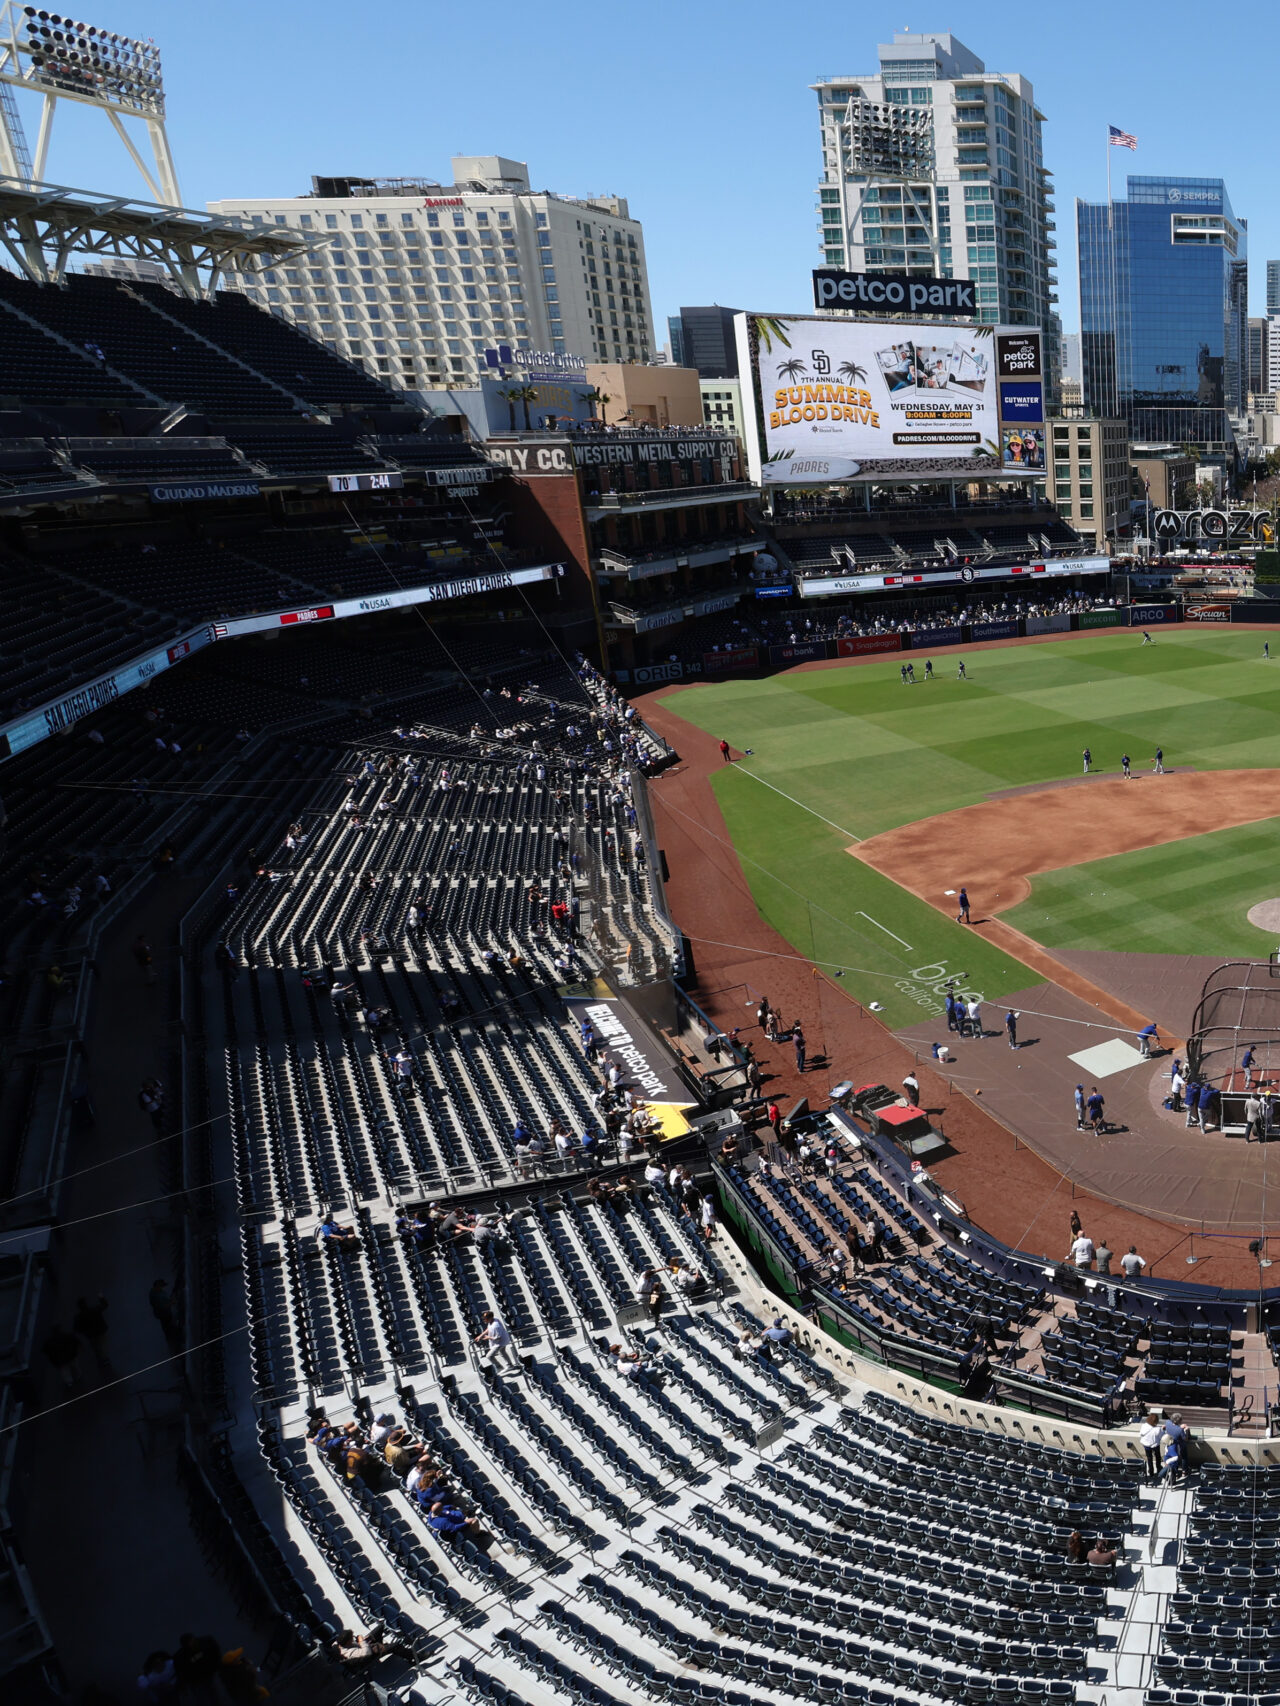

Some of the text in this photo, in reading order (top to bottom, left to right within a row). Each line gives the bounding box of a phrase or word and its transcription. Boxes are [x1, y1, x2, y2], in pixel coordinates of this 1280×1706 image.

[1183, 191, 1220, 201] SEMPRA
[423, 198, 463, 208] Marriott
[817, 275, 973, 311] petco park
[515, 349, 586, 369] QuidelOrtho
[1004, 352, 1035, 363] petco
[1010, 361, 1035, 371] park
[815, 376, 844, 384] ANNUAL
[774, 384, 873, 409] SUMMER
[1004, 396, 1040, 404] CUTWATER
[891, 403, 985, 412] WEDNESDAY, MAY 31
[769, 404, 881, 430] BLOOD DRIVE
[905, 411, 972, 419] 9:00AM 6:00PM
[897, 434, 977, 442] PADRES.COM/BLOODDRIVE
[573, 441, 737, 465] WESTERN METAL SUPPLY CO.
[536, 448, 573, 471] CO.
[790, 460, 830, 475] PADRES
[370, 475, 390, 489] 2:44
[436, 468, 487, 485] CUTWATER
[154, 484, 260, 500] CIUDAD MADERAS
[447, 486, 479, 498] SPIRITS
[1184, 510, 1271, 540] razr
[429, 573, 513, 601] SAN DIEGO PADRES
[842, 581, 860, 589] USAA
[758, 588, 788, 597] PARADYM
[369, 598, 391, 611] USAA
[296, 610, 318, 621] PADRES
[1083, 614, 1117, 624] dexcom
[1132, 609, 1164, 621] ARCO
[1186, 605, 1226, 621] Sycuan
[974, 625, 1011, 637] Southwest
[855, 639, 897, 650] Snapdragon
[794, 647, 815, 656] bank
[636, 664, 682, 682] ORIS
[685, 663, 702, 673] 342
[43, 675, 119, 732] SAN DIEGO PADRES
[608, 1033, 634, 1047] TO
[612, 1044, 650, 1073] petco
[631, 1071, 668, 1098] park
